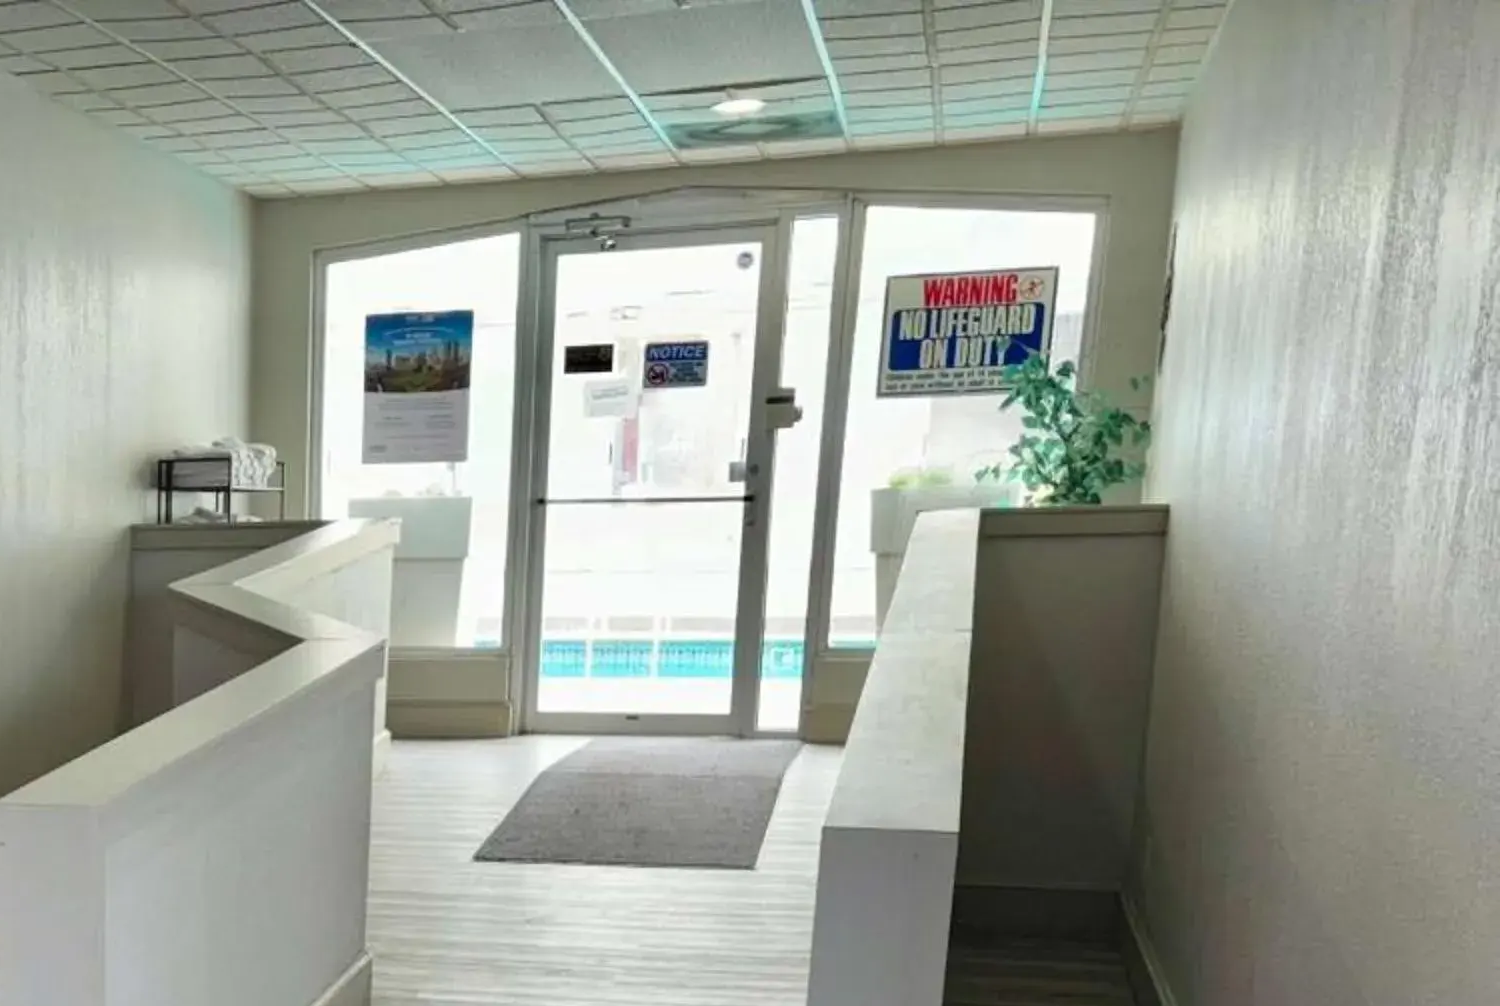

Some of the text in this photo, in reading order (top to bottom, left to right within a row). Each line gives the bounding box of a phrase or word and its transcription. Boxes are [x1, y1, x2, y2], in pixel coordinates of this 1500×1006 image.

[923, 274, 1018, 307] WARNING
[899, 303, 1036, 340] NO LIFEGUARD
[650, 345, 705, 360] NOTICE
[919, 335, 1012, 369] ON DUTY
